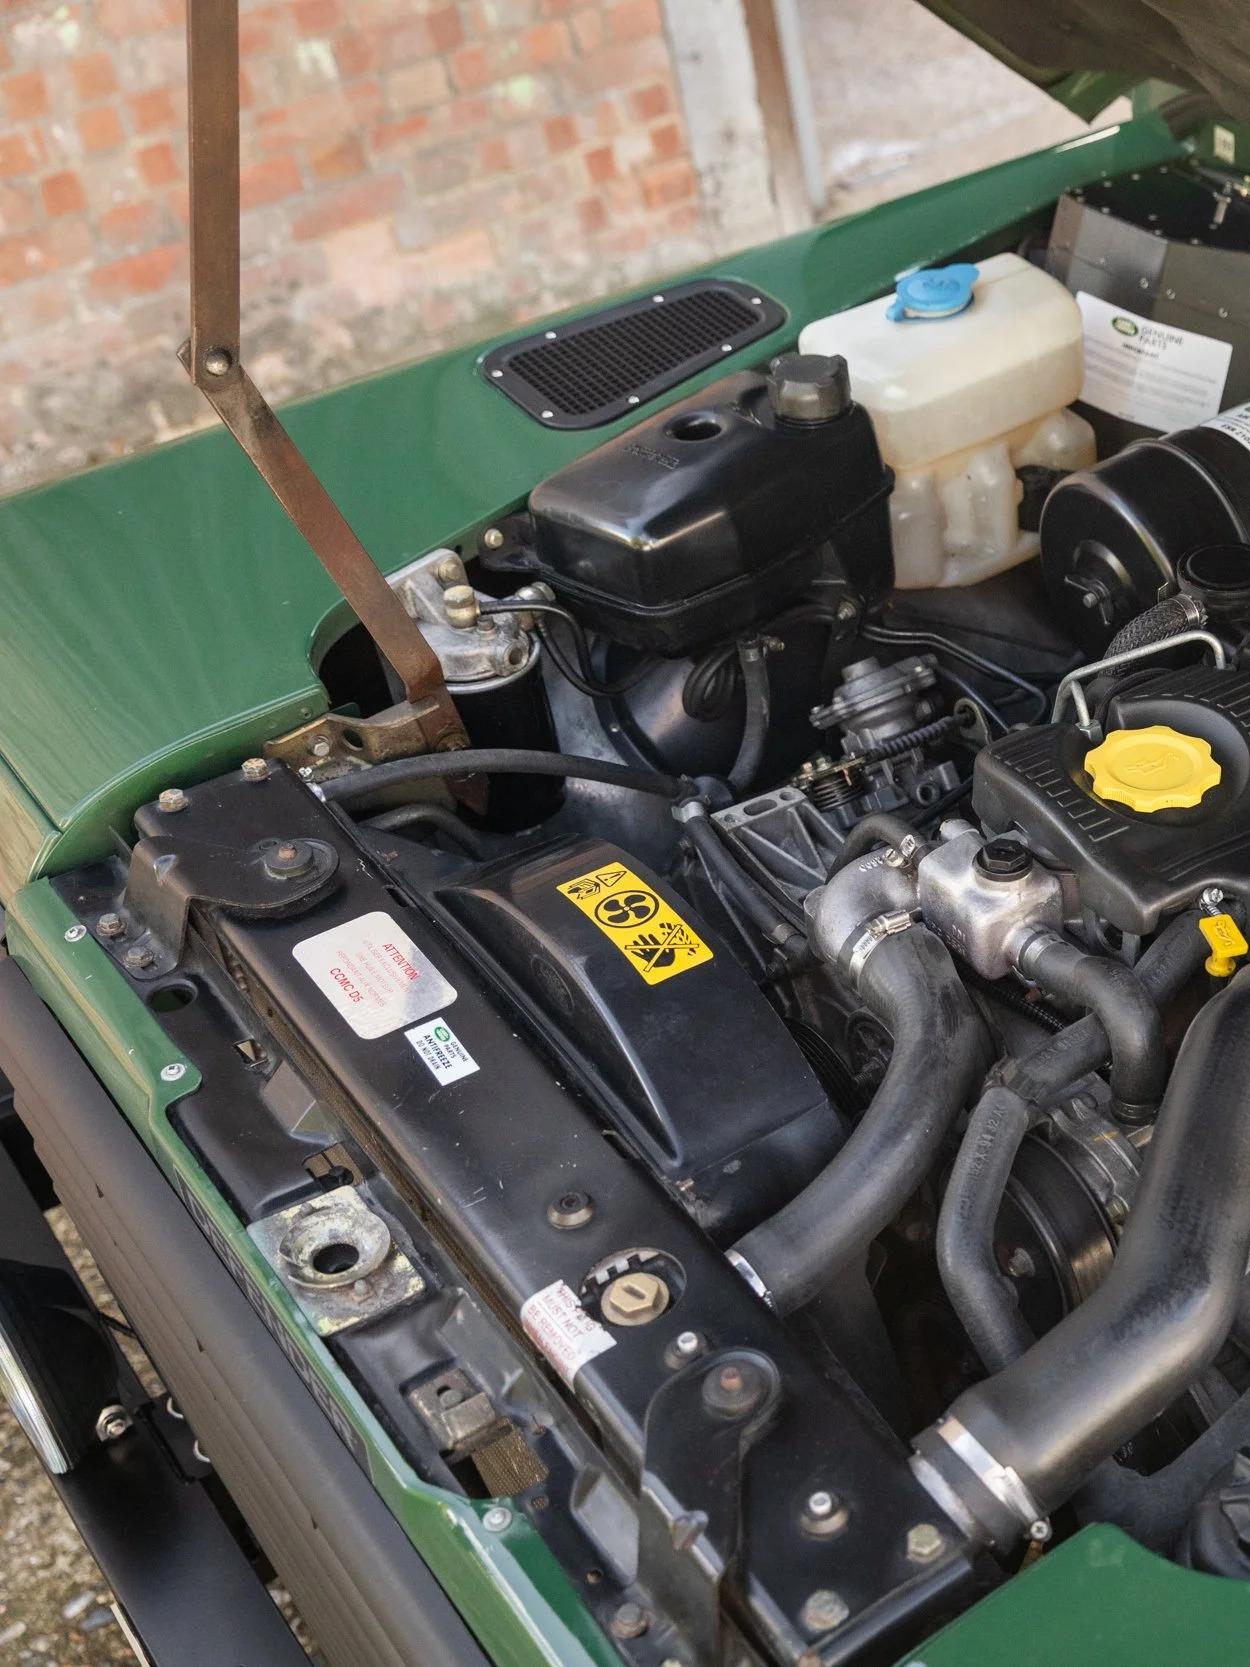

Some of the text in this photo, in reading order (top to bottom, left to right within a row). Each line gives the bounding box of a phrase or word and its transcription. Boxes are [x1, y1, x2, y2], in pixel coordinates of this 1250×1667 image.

[383, 942, 420, 981] ATTENTION
[424, 1034, 453, 1069] ANTIFREEZE
[444, 1044, 456, 1059] PARTS
[450, 1041, 468, 1063] GENUINE
[561, 1320, 583, 1338] NOT
